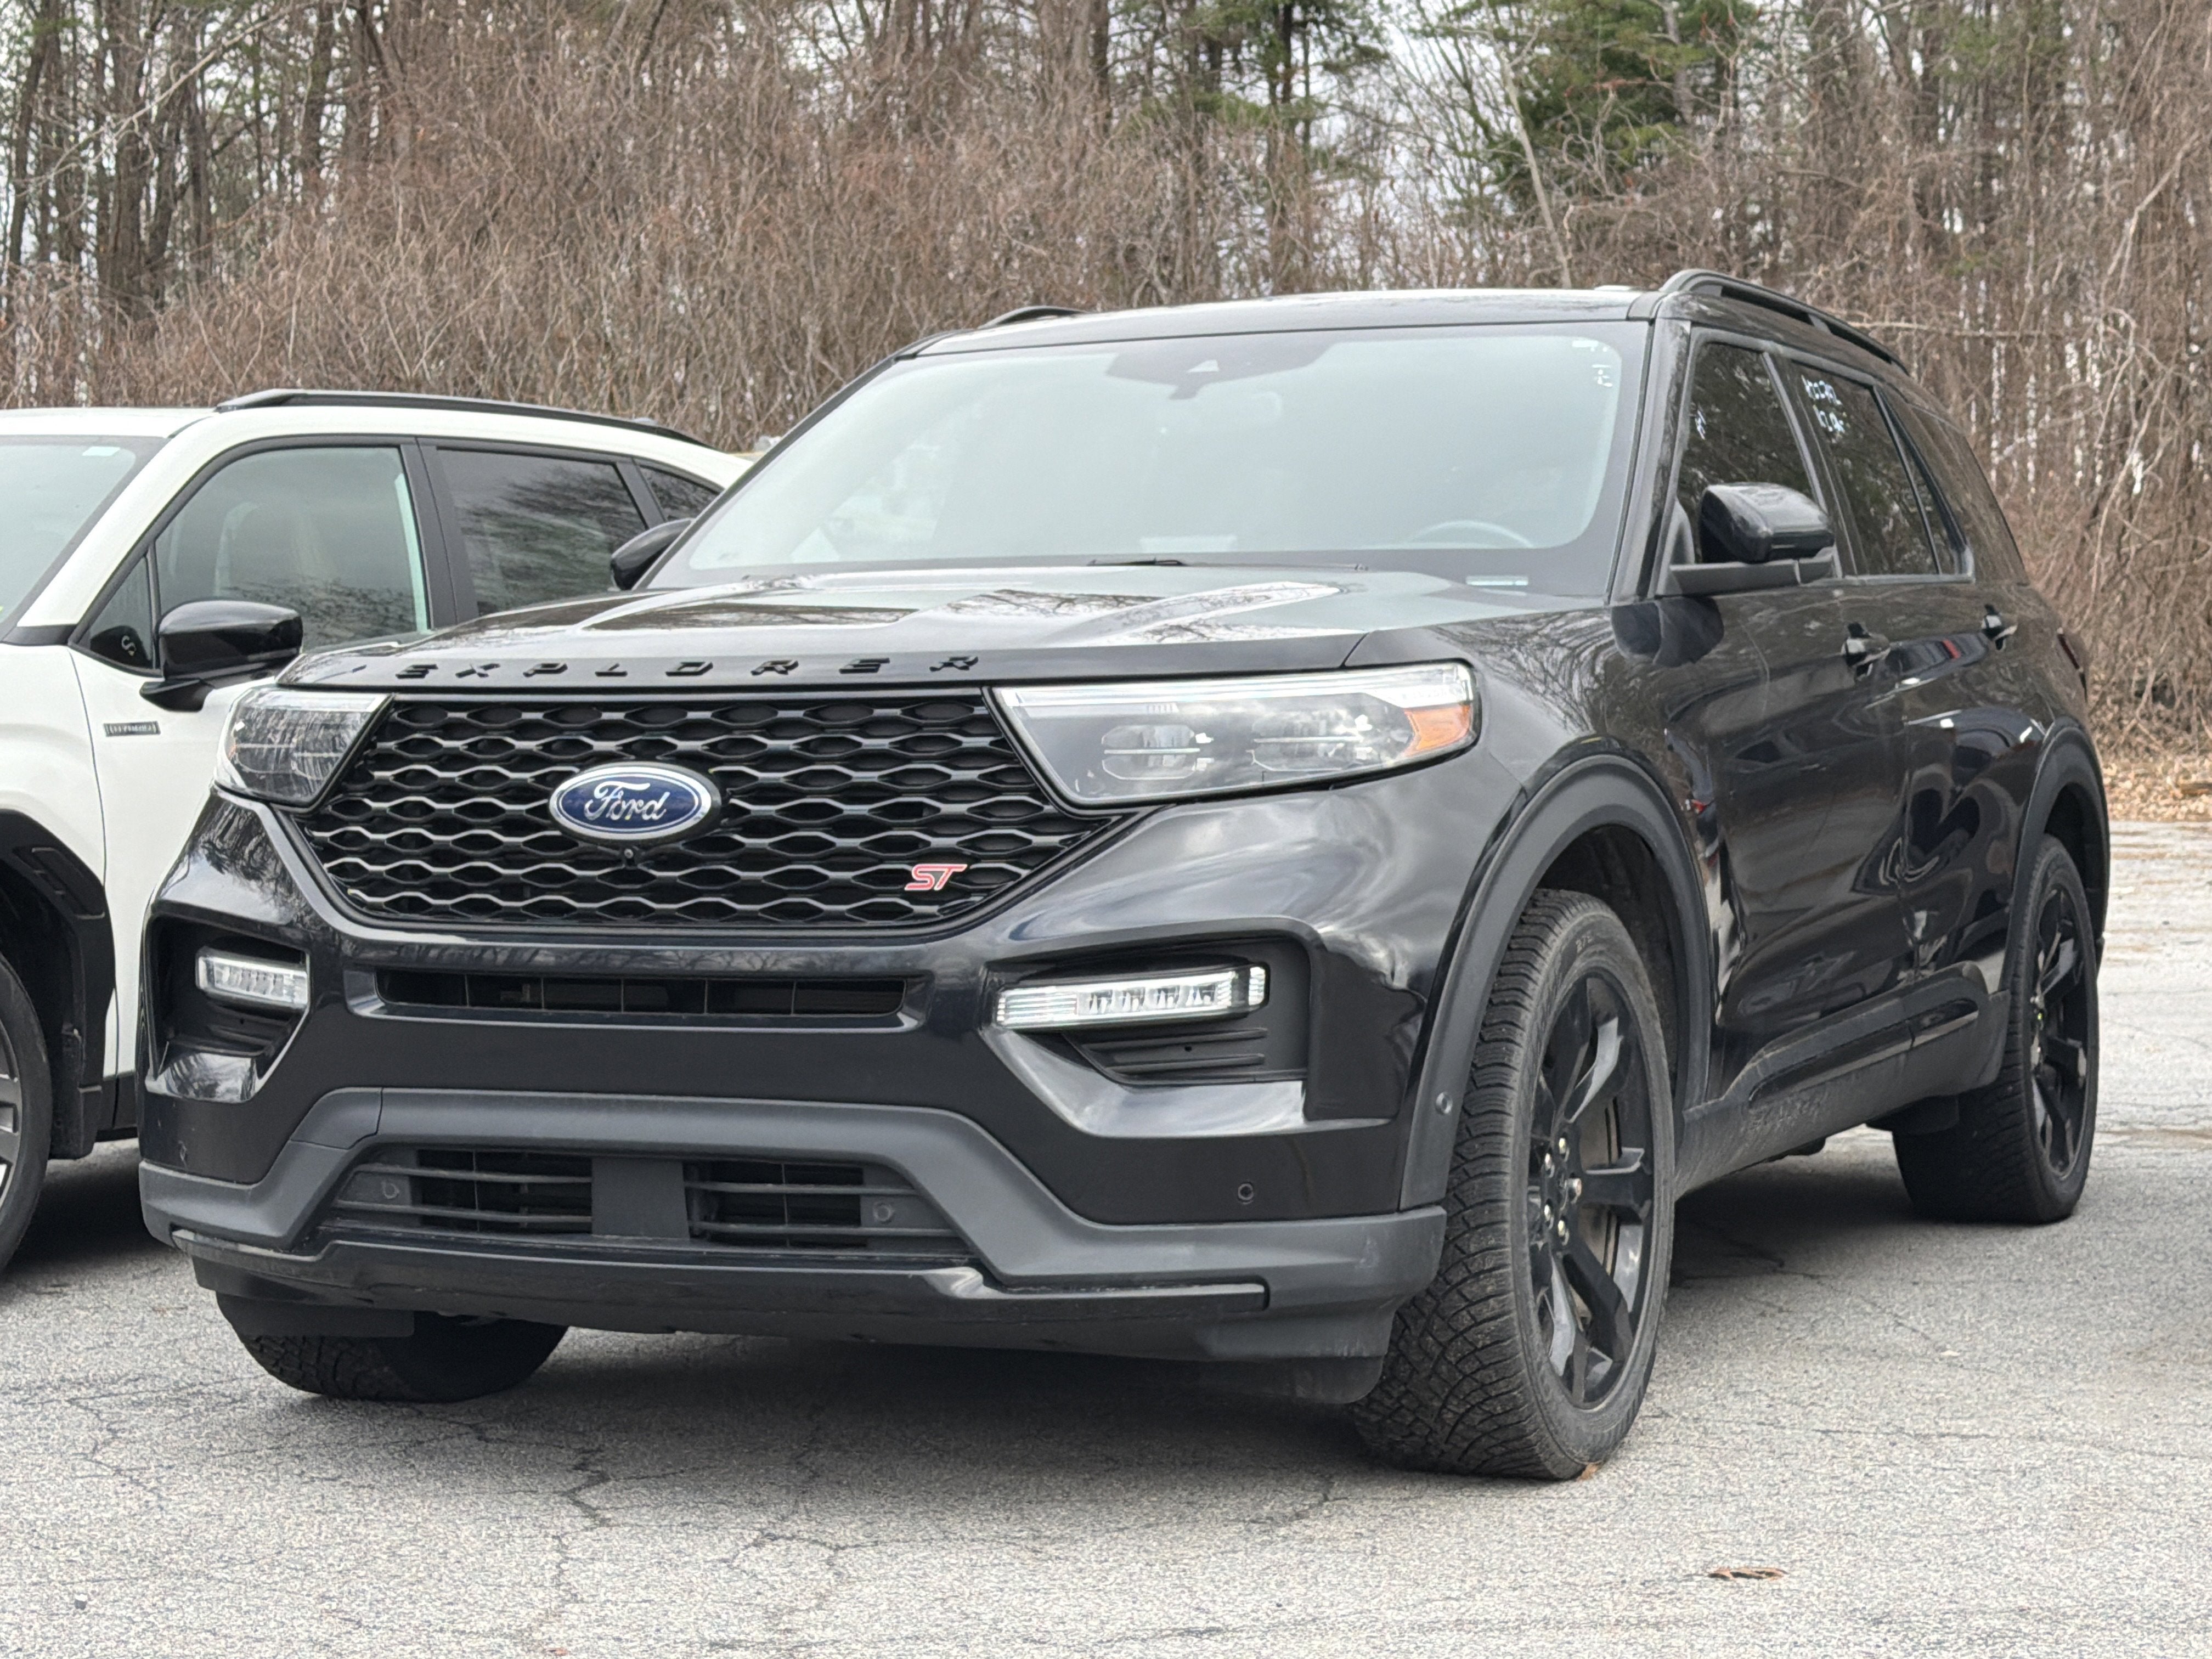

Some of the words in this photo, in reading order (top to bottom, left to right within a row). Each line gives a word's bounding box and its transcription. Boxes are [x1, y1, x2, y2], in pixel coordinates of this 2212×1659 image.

[395, 656, 979, 679] EXPLORER
[584, 780, 671, 821] Ford
[904, 863, 968, 891] ST
